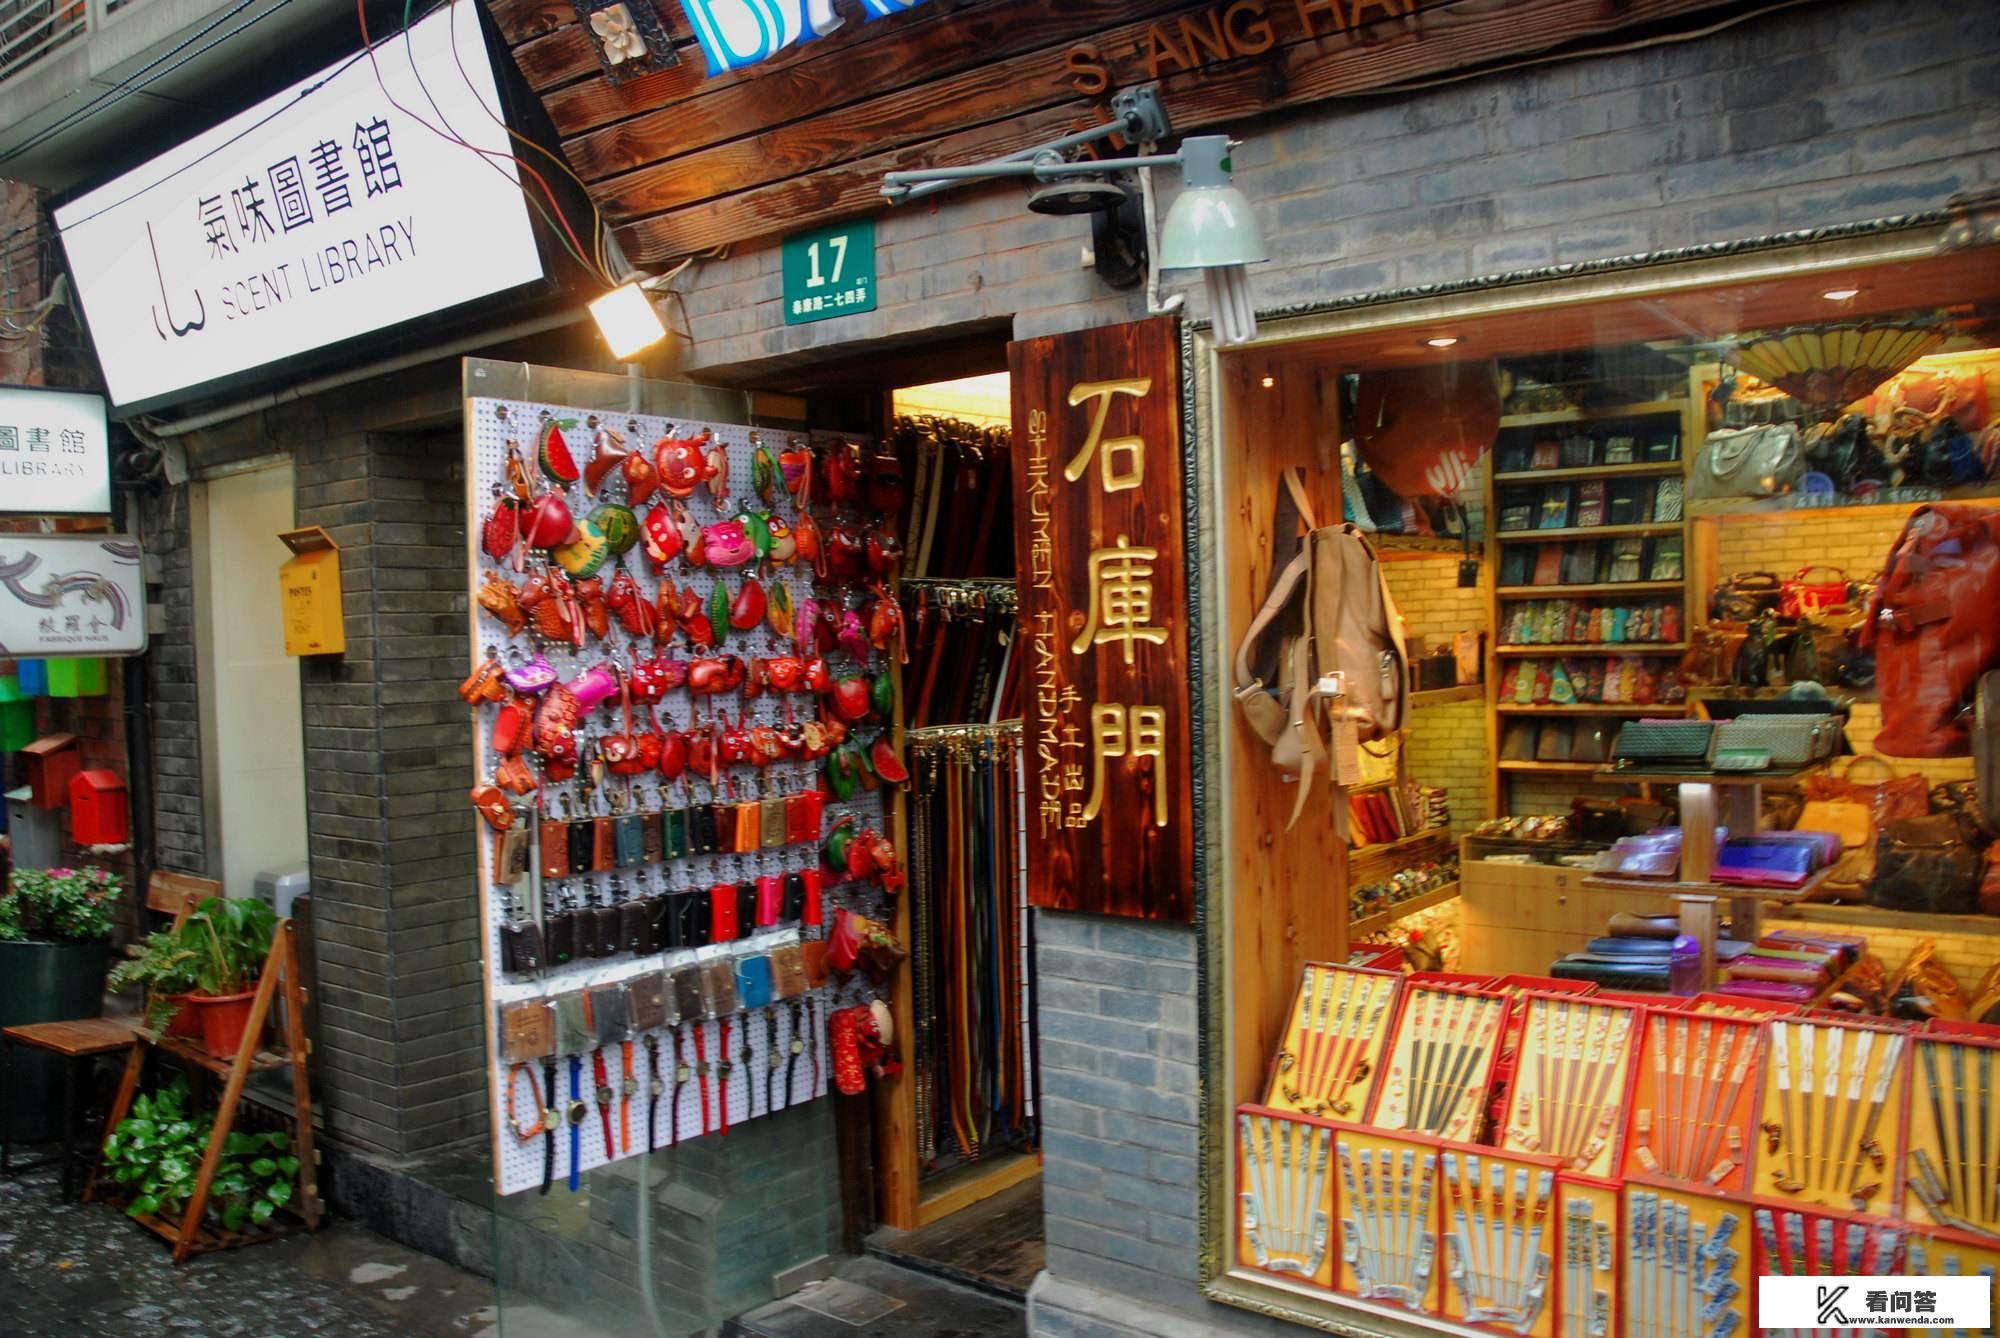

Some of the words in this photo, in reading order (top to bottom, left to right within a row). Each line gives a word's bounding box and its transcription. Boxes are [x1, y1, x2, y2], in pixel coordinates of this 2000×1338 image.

[199, 116, 402, 260] 氣味圖書館
[222, 264, 292, 320] SCENT
[302, 216, 416, 292] LIBRARY
[806, 235, 848, 288] 17
[1027, 408, 1053, 588] SHIKUMEN
[1064, 376, 1169, 827] 石庫門
[1033, 610, 1062, 840] HANDMADE
